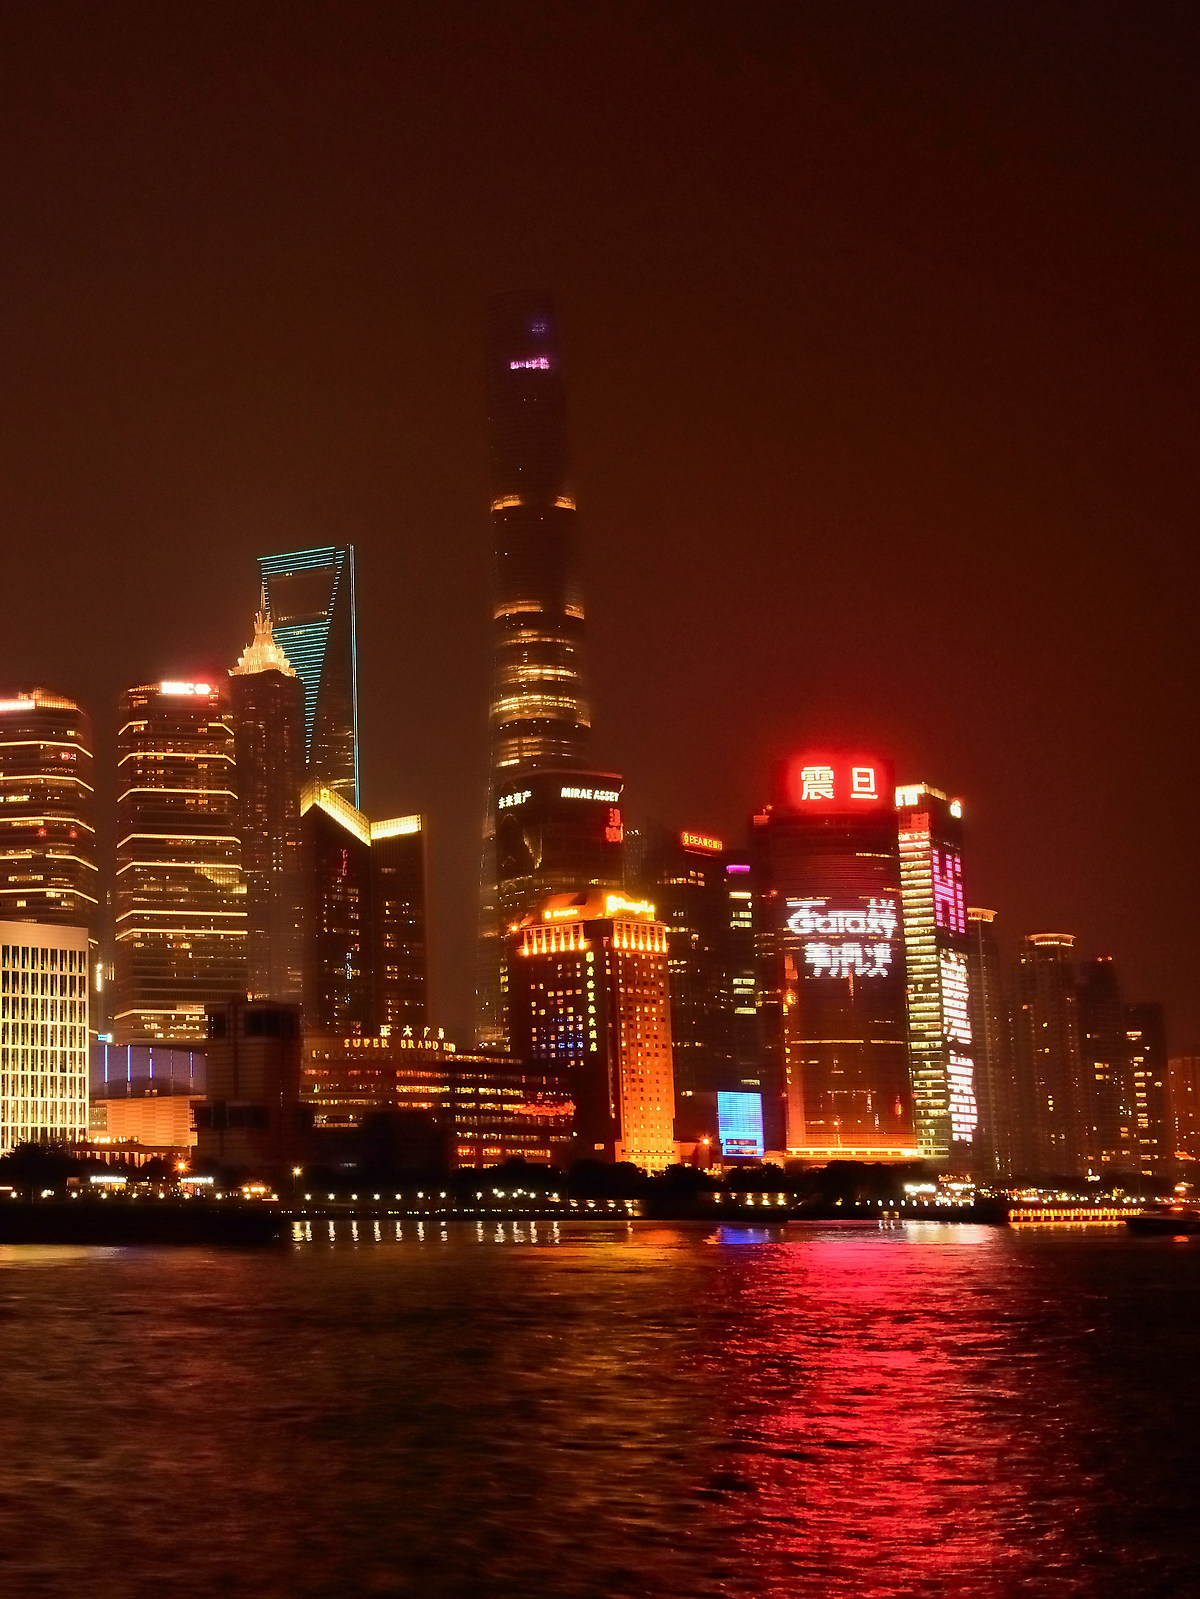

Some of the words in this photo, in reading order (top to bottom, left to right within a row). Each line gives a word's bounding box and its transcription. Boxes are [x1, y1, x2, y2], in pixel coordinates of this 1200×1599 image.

[801, 766, 878, 800] 震旦
[561, 787, 592, 799] MIRAE
[344, 1038, 390, 1048] SUPER
[400, 1039, 439, 1050] BRAND
